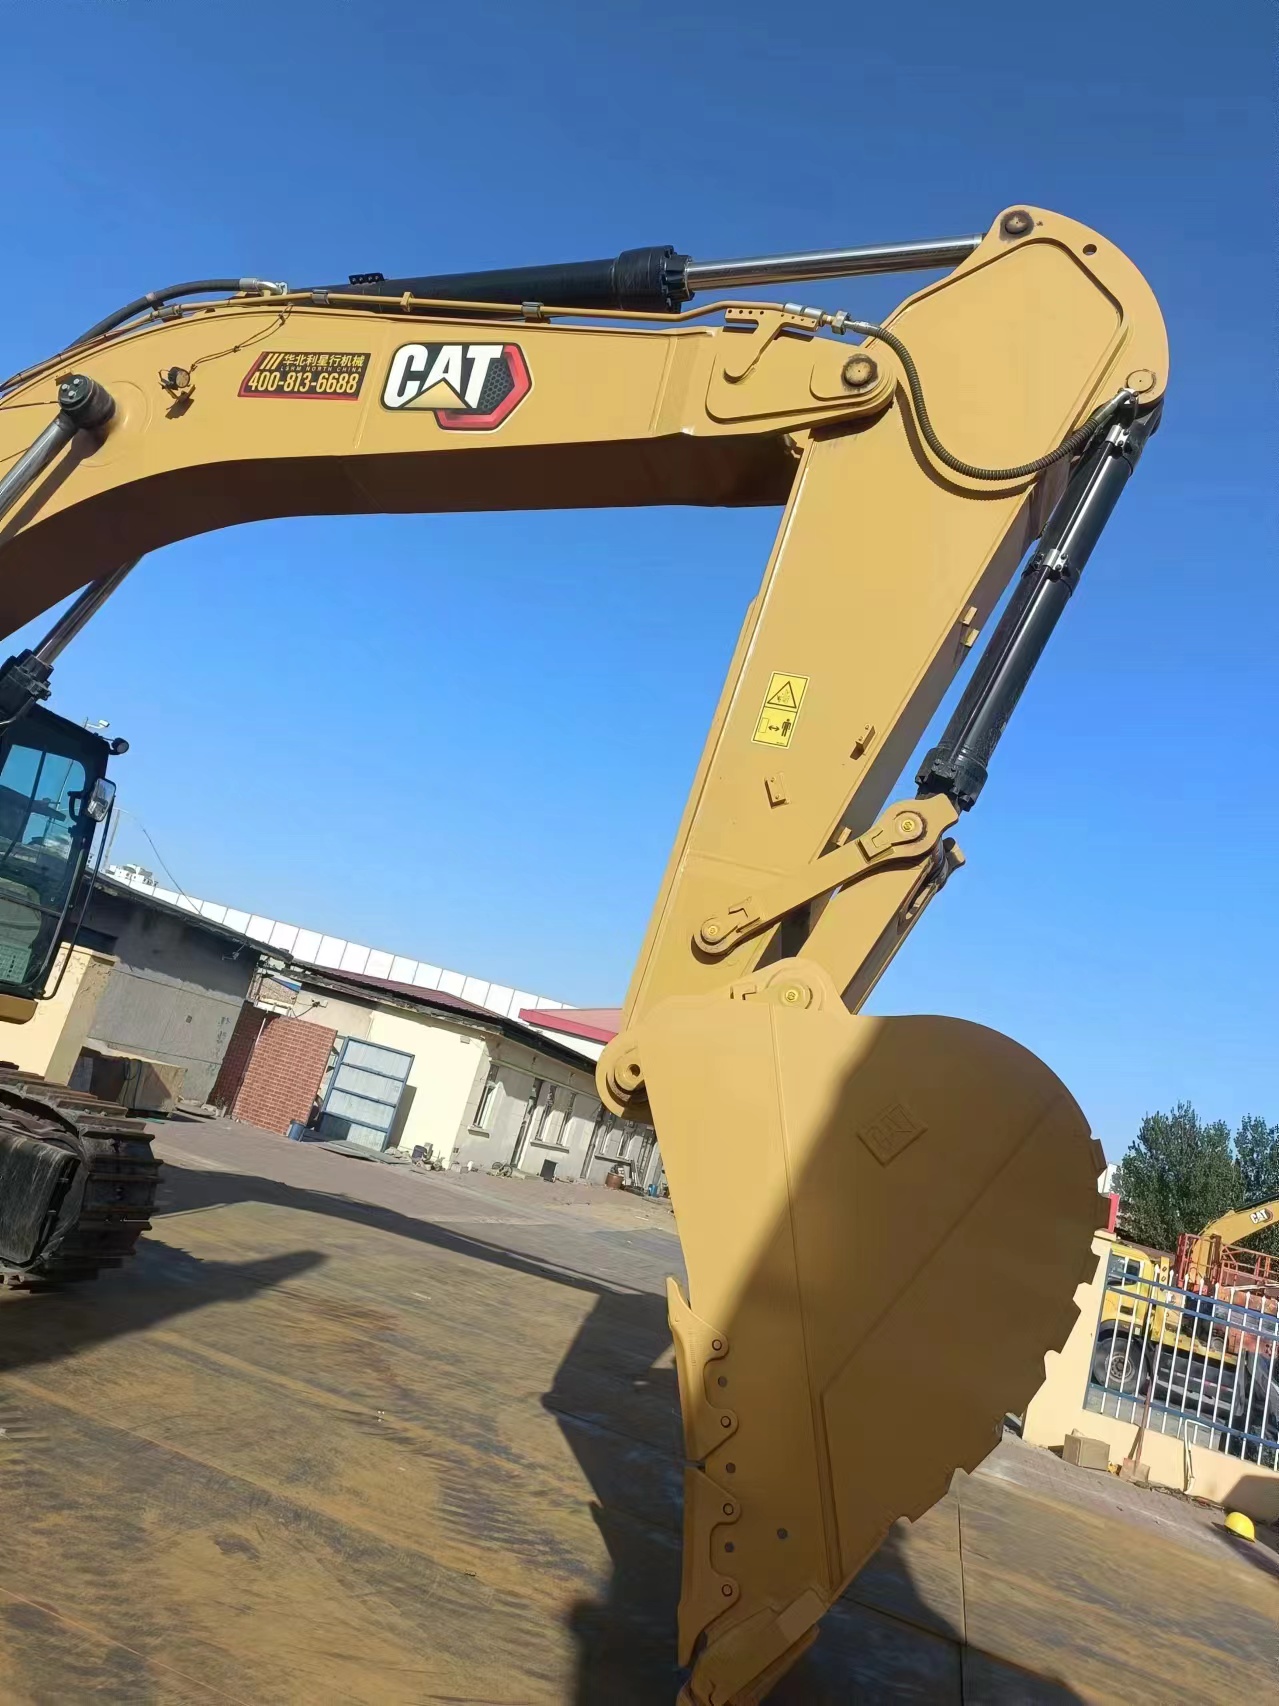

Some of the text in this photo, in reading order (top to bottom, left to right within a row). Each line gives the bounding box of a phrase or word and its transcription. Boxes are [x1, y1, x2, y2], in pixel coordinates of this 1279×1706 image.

[283, 354, 365, 367] 华北利星行机械
[248, 372, 359, 393] 400-813-6688
[383, 343, 504, 408] CAT
[1250, 1209, 1268, 1224] CAT
